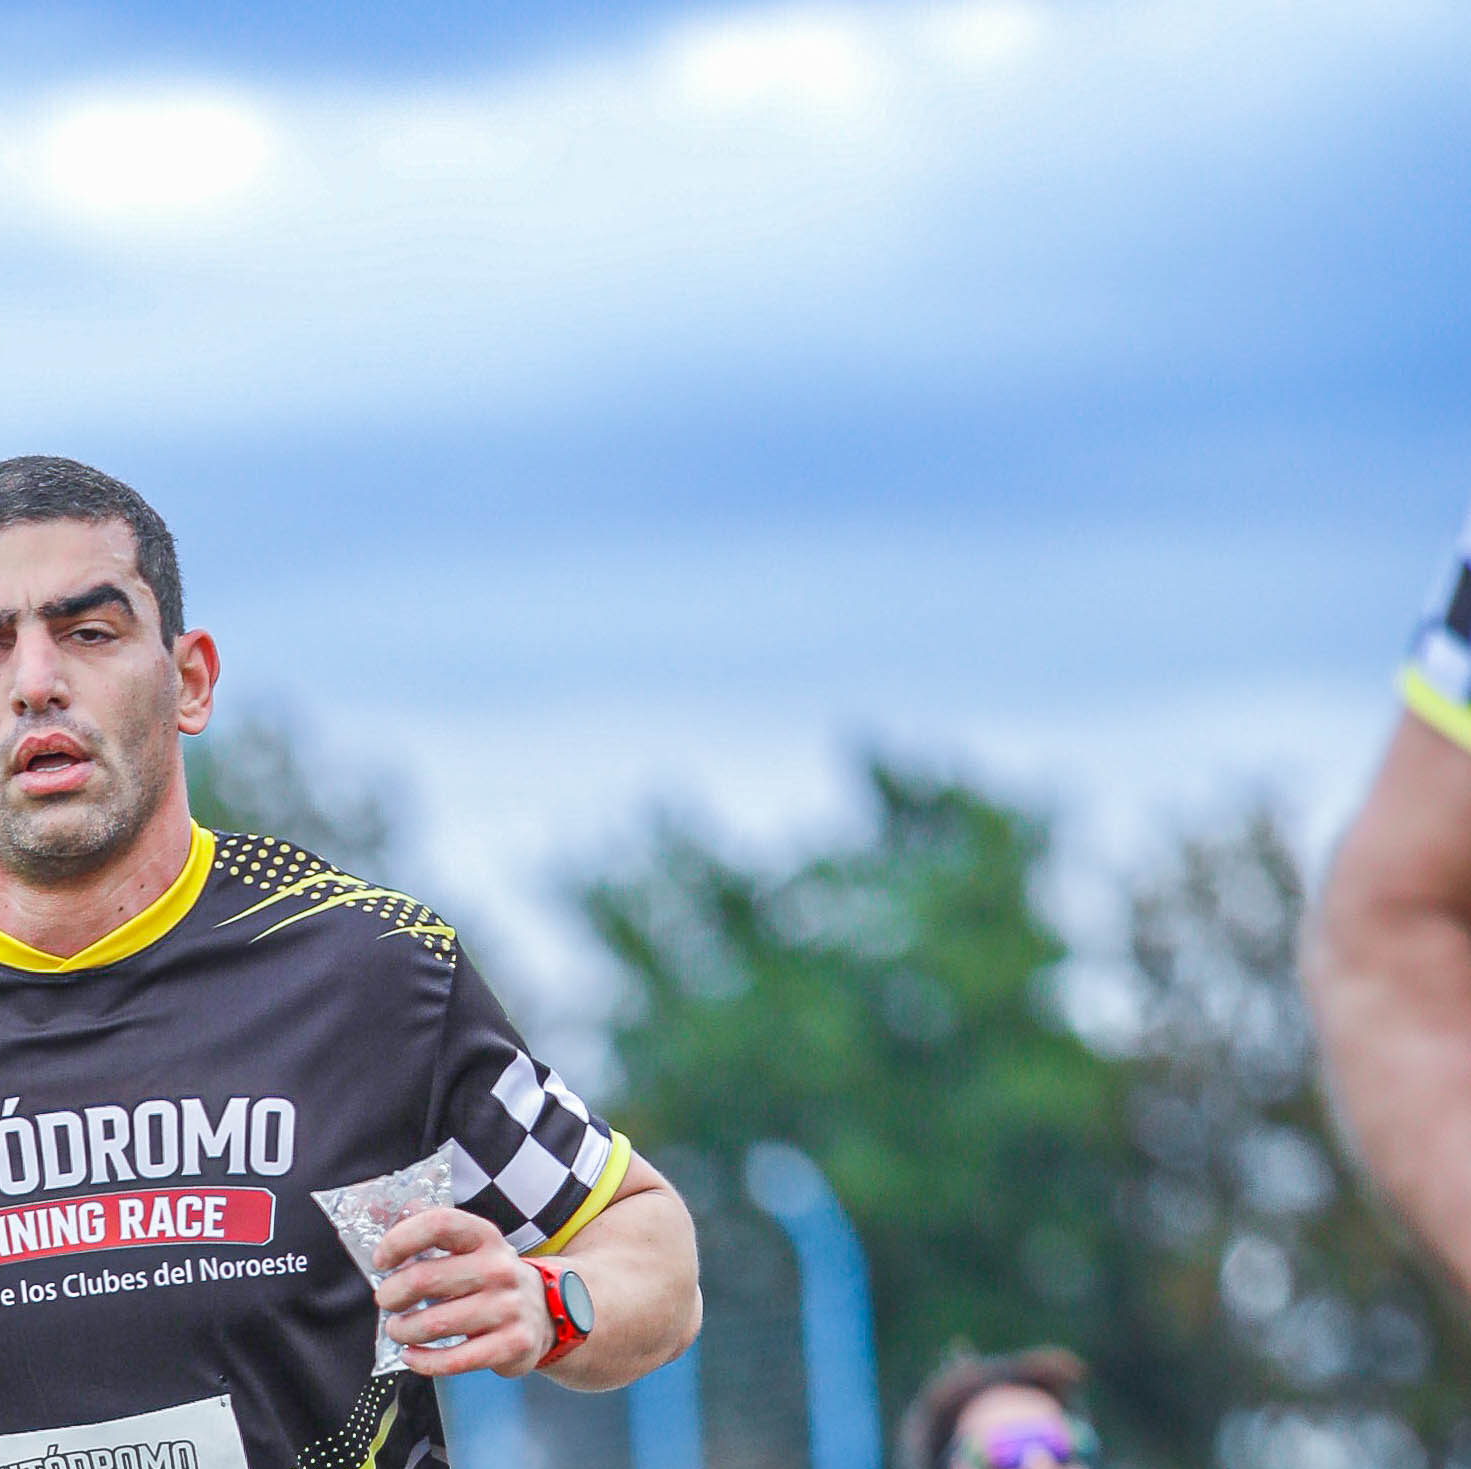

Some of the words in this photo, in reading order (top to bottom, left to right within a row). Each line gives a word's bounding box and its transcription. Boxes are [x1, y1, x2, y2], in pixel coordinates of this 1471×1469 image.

[119, 1195, 227, 1241] RACE
[20, 1279, 57, 1304] los
[62, 1269, 148, 1298] Clubes
[153, 1259, 192, 1287] del
[199, 1252, 308, 1282] Noroeste
